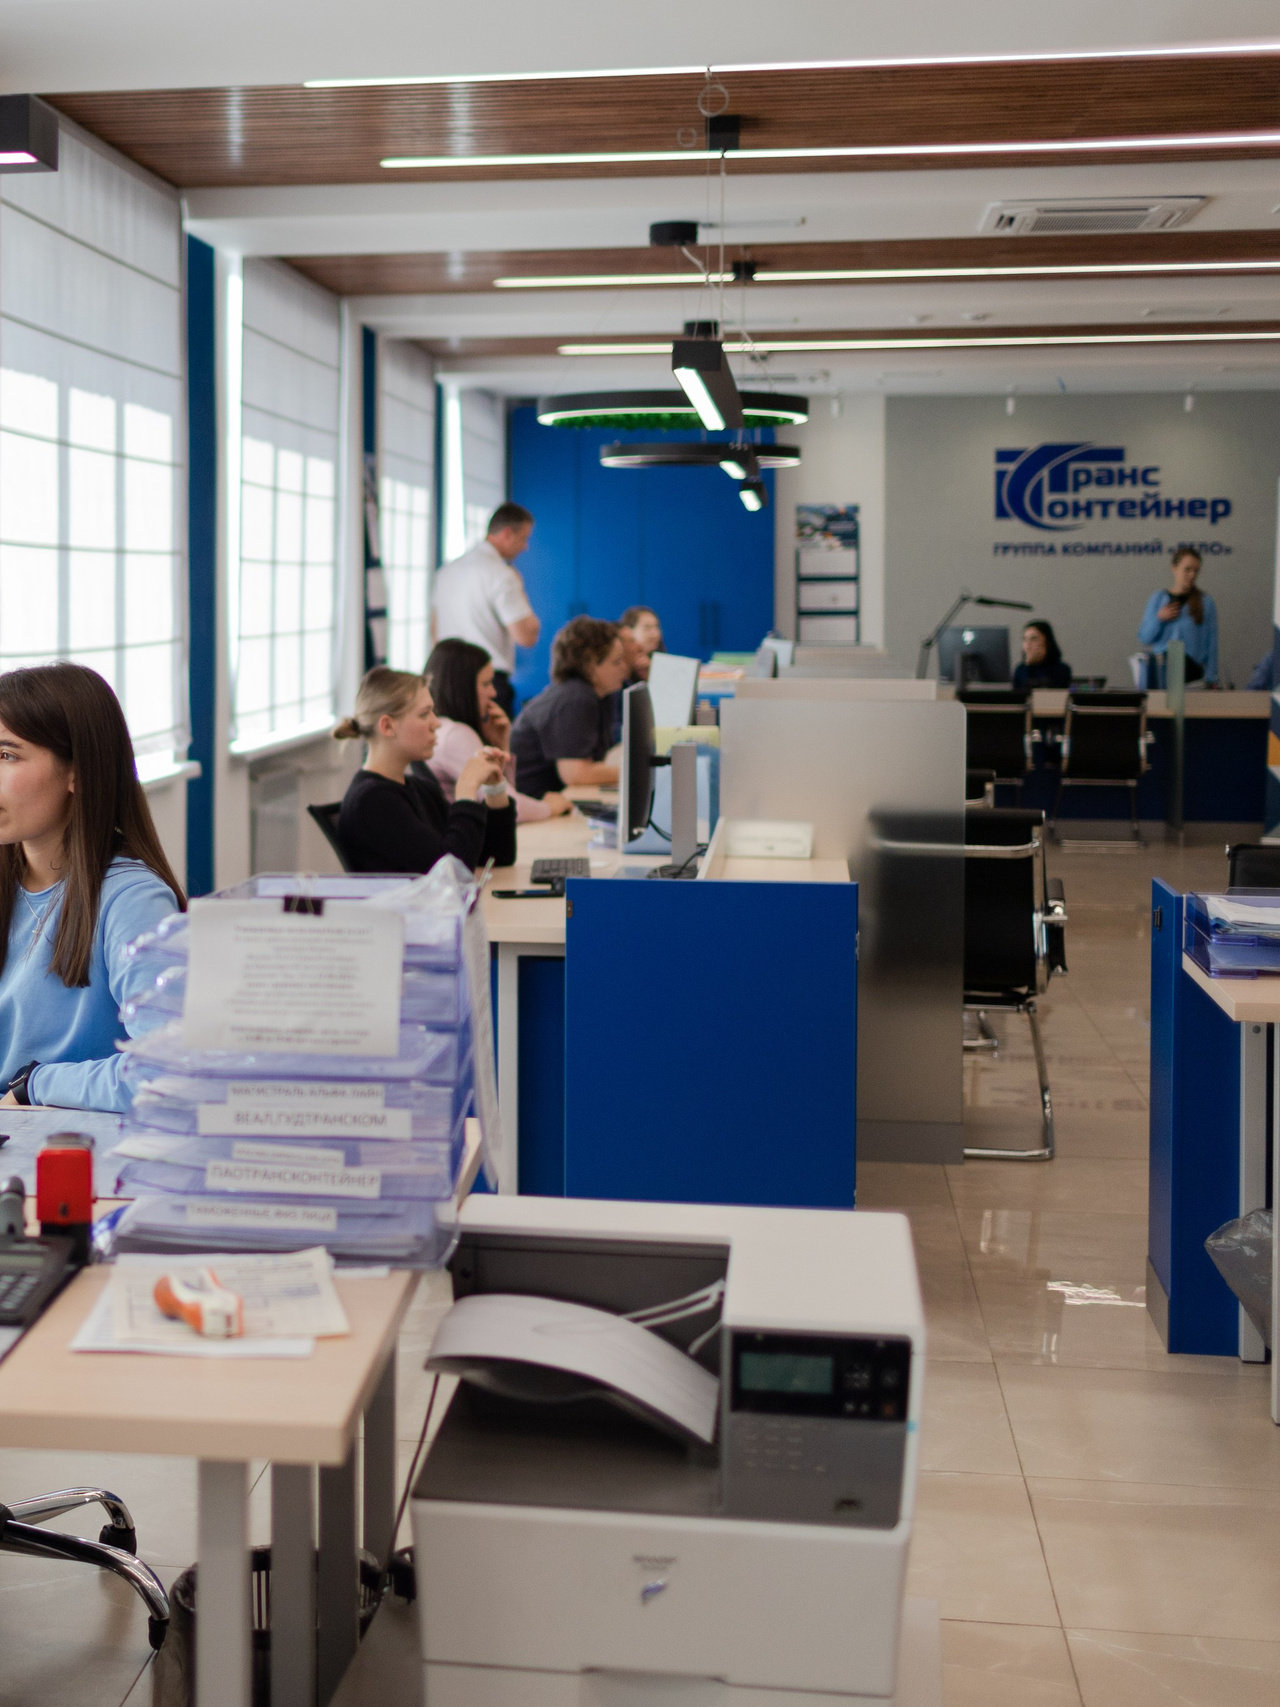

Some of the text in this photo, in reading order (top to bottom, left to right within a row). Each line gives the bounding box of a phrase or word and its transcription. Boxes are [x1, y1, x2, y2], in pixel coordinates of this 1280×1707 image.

[993, 541, 1058, 557] ГРУППА
[1062, 538, 1164, 557] КОМПАНИЙ
[210, 1165, 379, 1188] ПАОТРАНСКОНТЕЙНЕР
